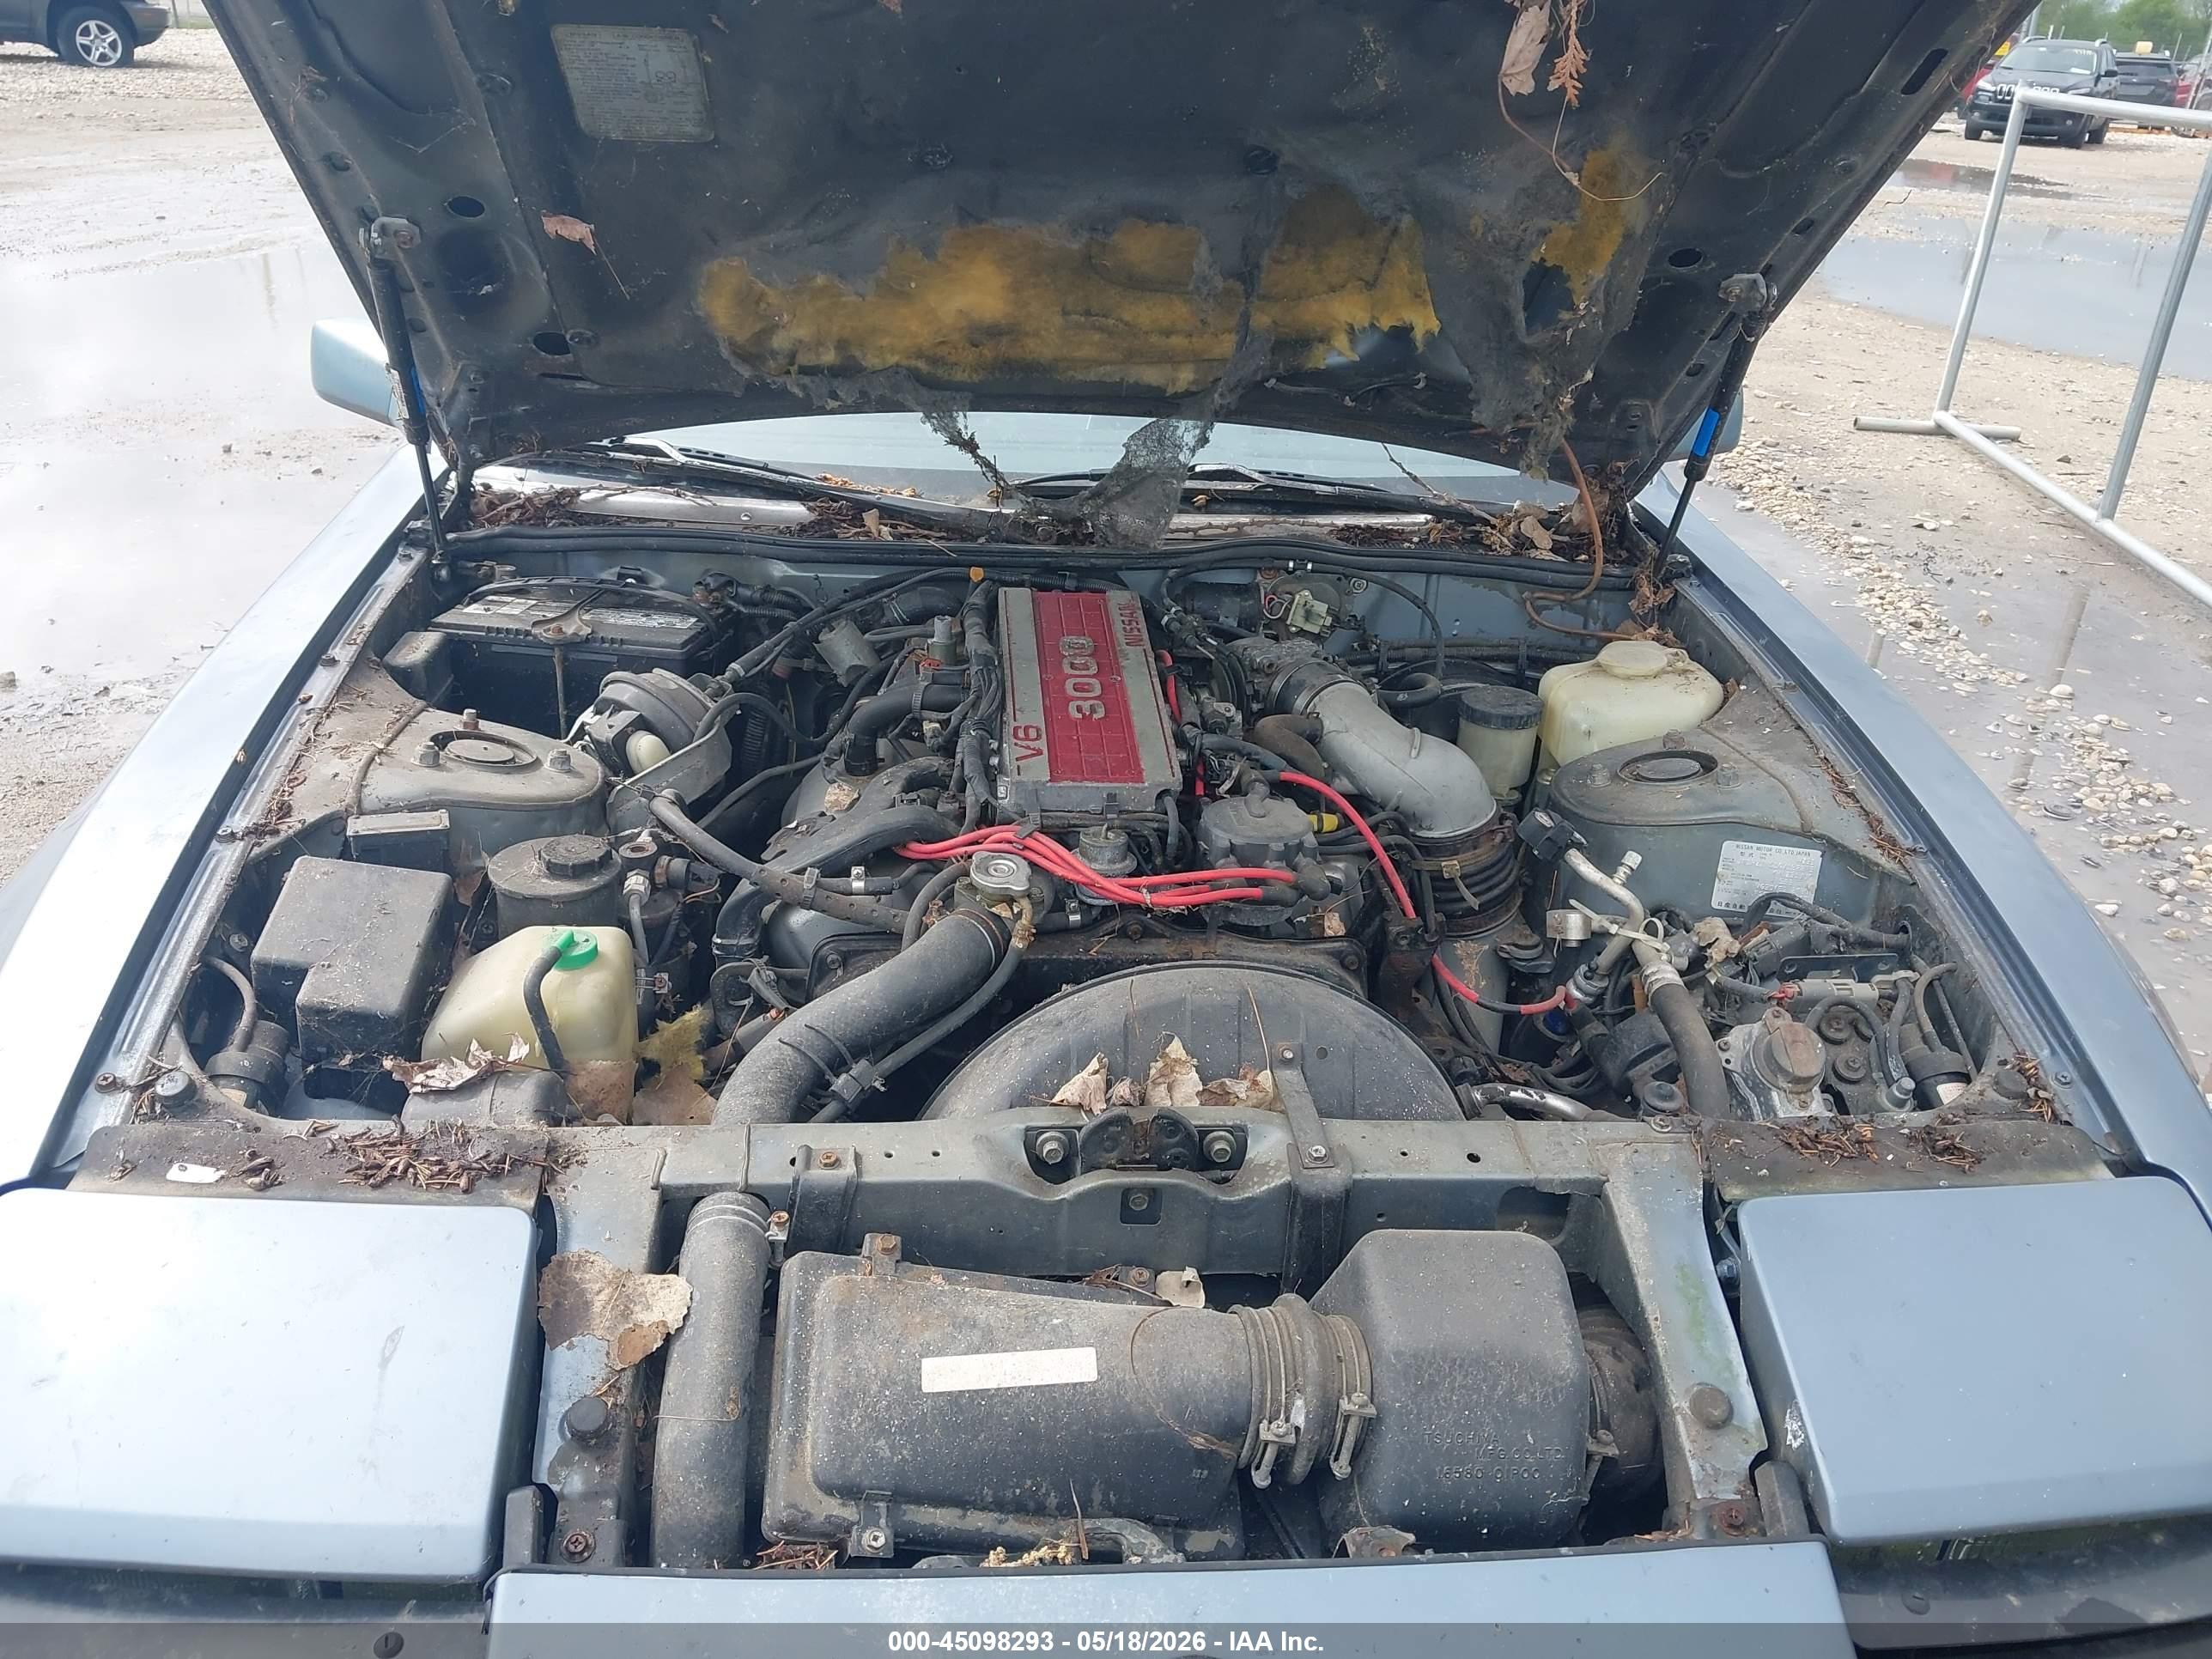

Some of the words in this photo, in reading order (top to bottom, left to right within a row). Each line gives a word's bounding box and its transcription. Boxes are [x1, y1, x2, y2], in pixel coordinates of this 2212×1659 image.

[1117, 603, 1145, 647] NISSAN
[1059, 635, 1105, 720] 3000
[1012, 725, 1043, 762] V6
[1423, 1431, 1500, 1445] TSUCHIYA
